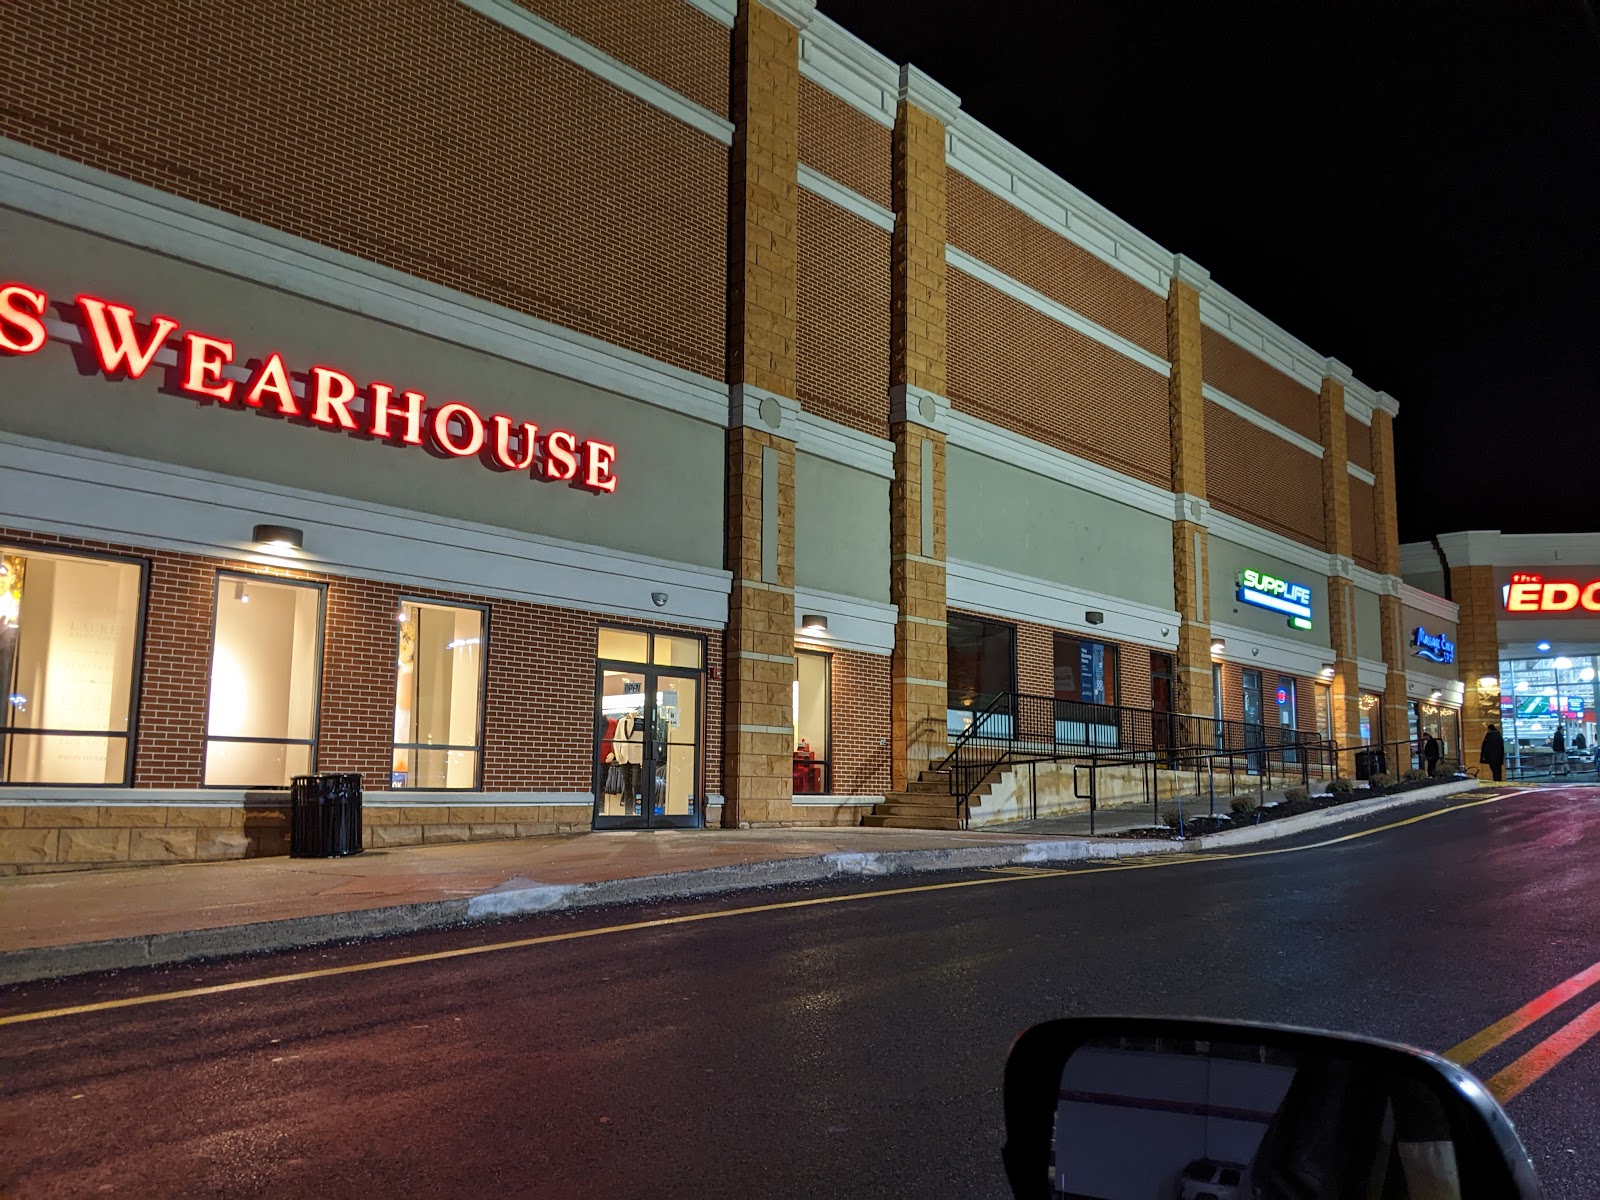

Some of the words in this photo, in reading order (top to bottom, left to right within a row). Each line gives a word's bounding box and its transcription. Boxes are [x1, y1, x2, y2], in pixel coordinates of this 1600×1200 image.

[78, 296, 618, 493] WEARHOUSE
[1243, 569, 1311, 605] SUPPLIFE
[1512, 574, 1541, 583] the
